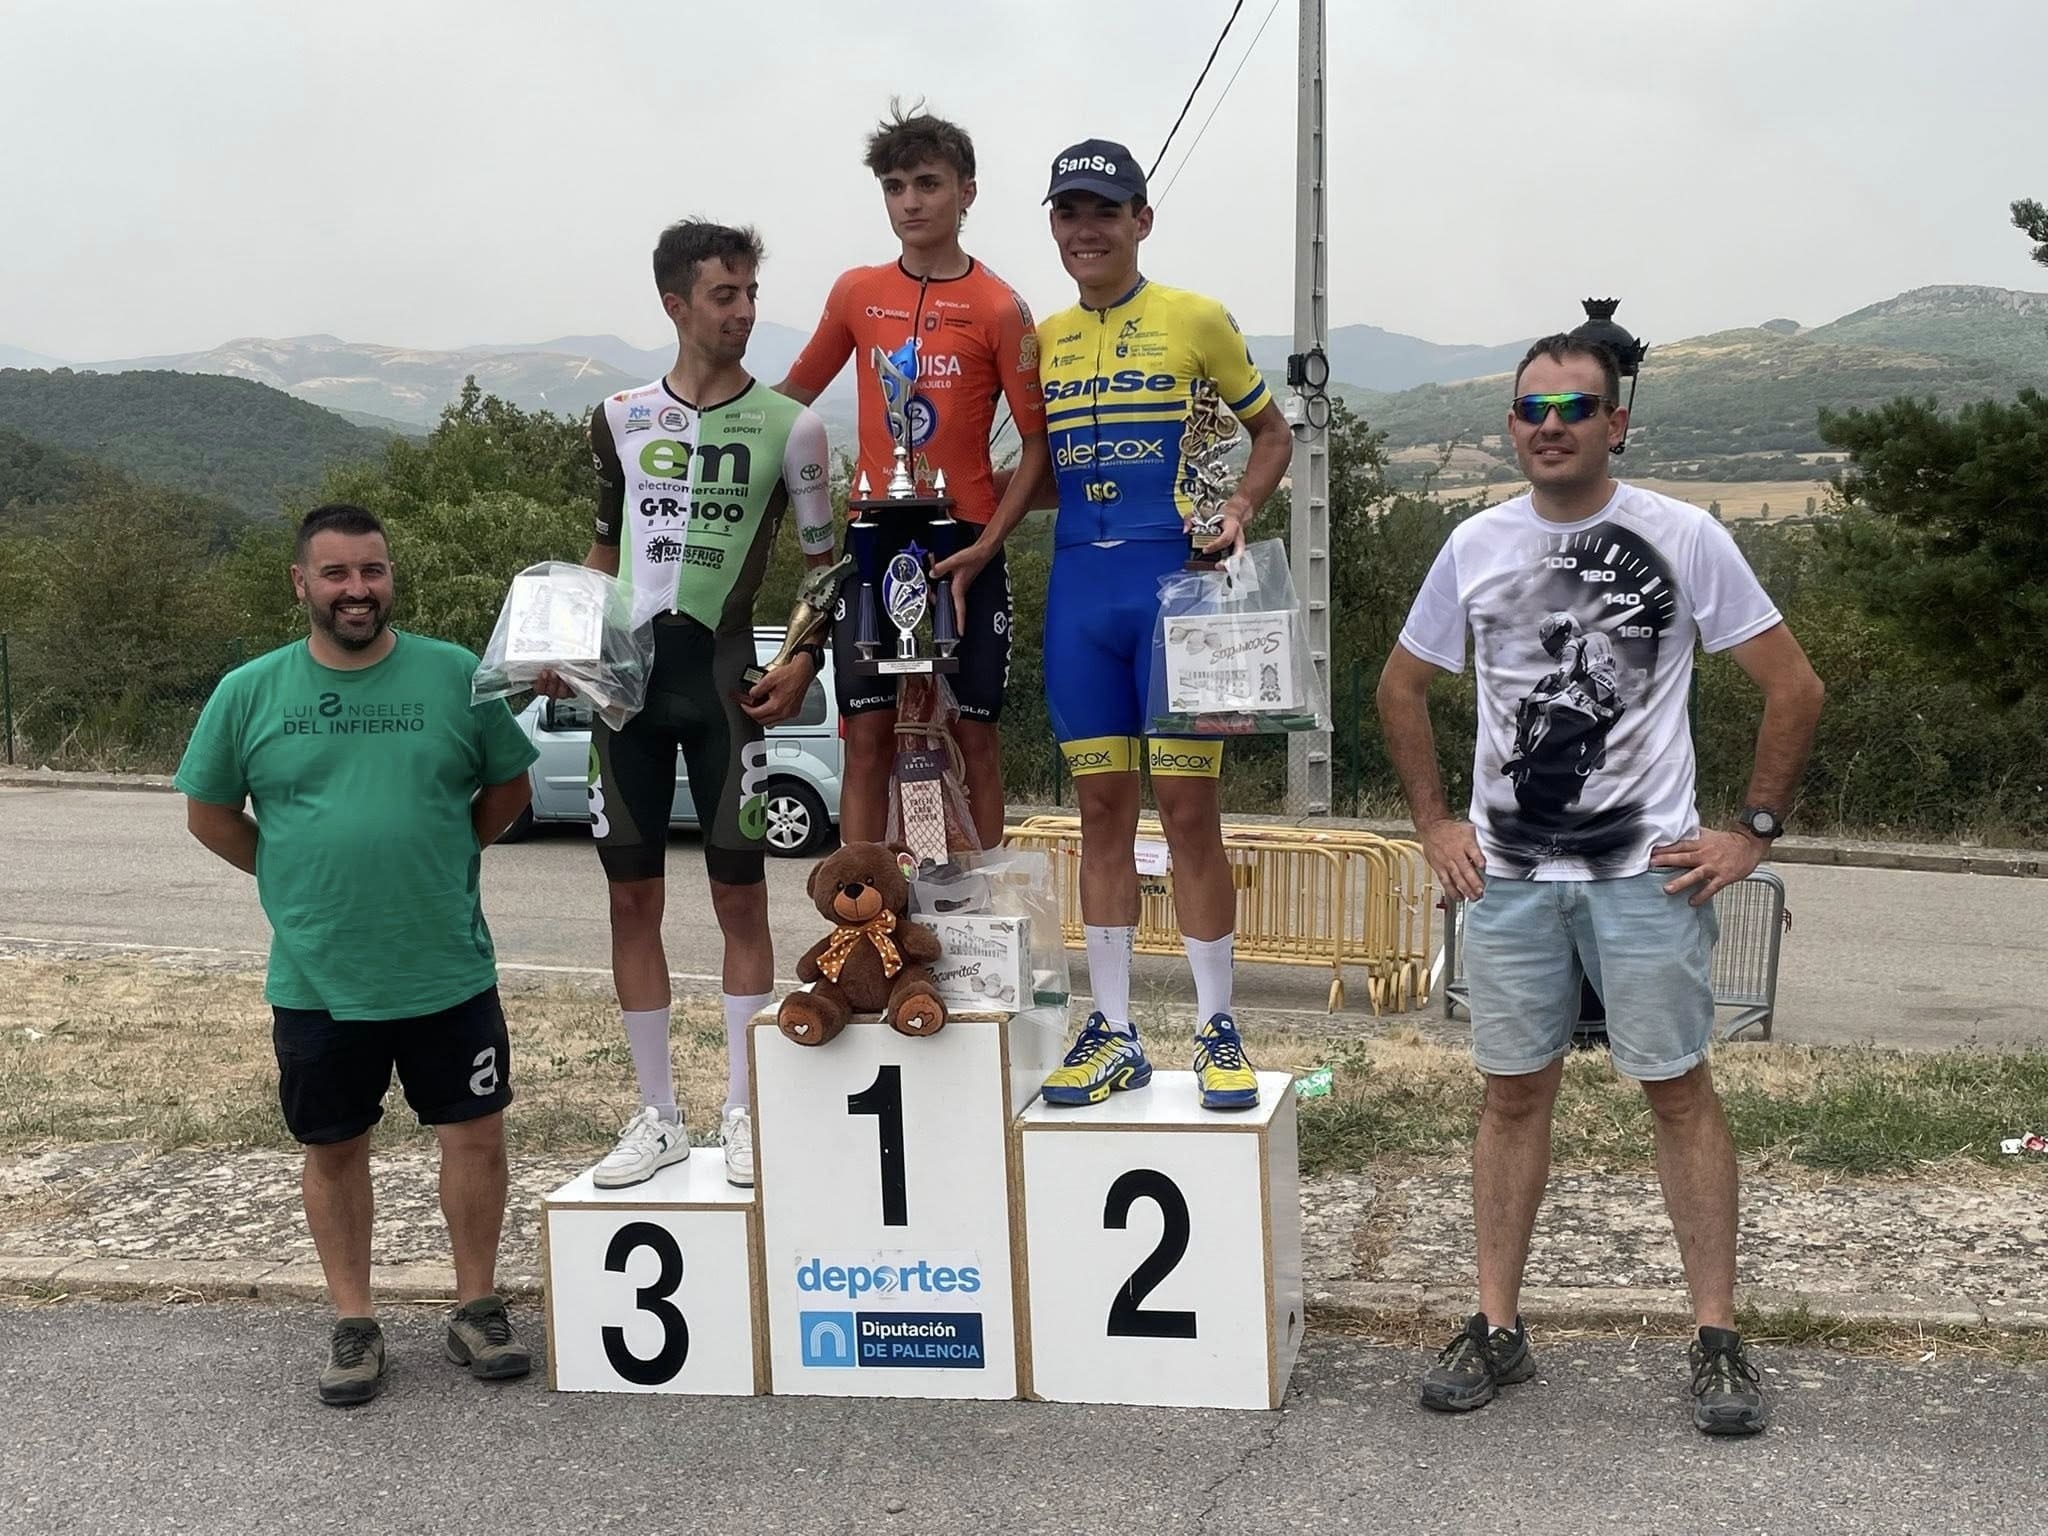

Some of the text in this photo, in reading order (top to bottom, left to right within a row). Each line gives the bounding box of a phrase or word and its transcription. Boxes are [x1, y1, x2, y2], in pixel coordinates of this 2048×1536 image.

[1058, 155, 1117, 176] SanSe
[1056, 433, 1165, 467] elecox
[639, 438, 751, 485] em
[1085, 481, 1118, 502] ISC
[640, 498, 744, 524] GR-100
[1542, 557, 1577, 569] 100
[1579, 570, 1616, 582] 120
[1602, 593, 1640, 605] 140
[1617, 625, 1653, 638] 160
[284, 718, 424, 735] DEL INFIERNO
[1151, 746, 1214, 769] elecox
[847, 1065, 908, 1226] 1
[1103, 1168, 1197, 1339] 2
[797, 1258, 981, 1300] deportes
[601, 1221, 690, 1386] 3
[862, 1320, 956, 1339] Diputación
[863, 1343, 980, 1359] DE PALENCIA
